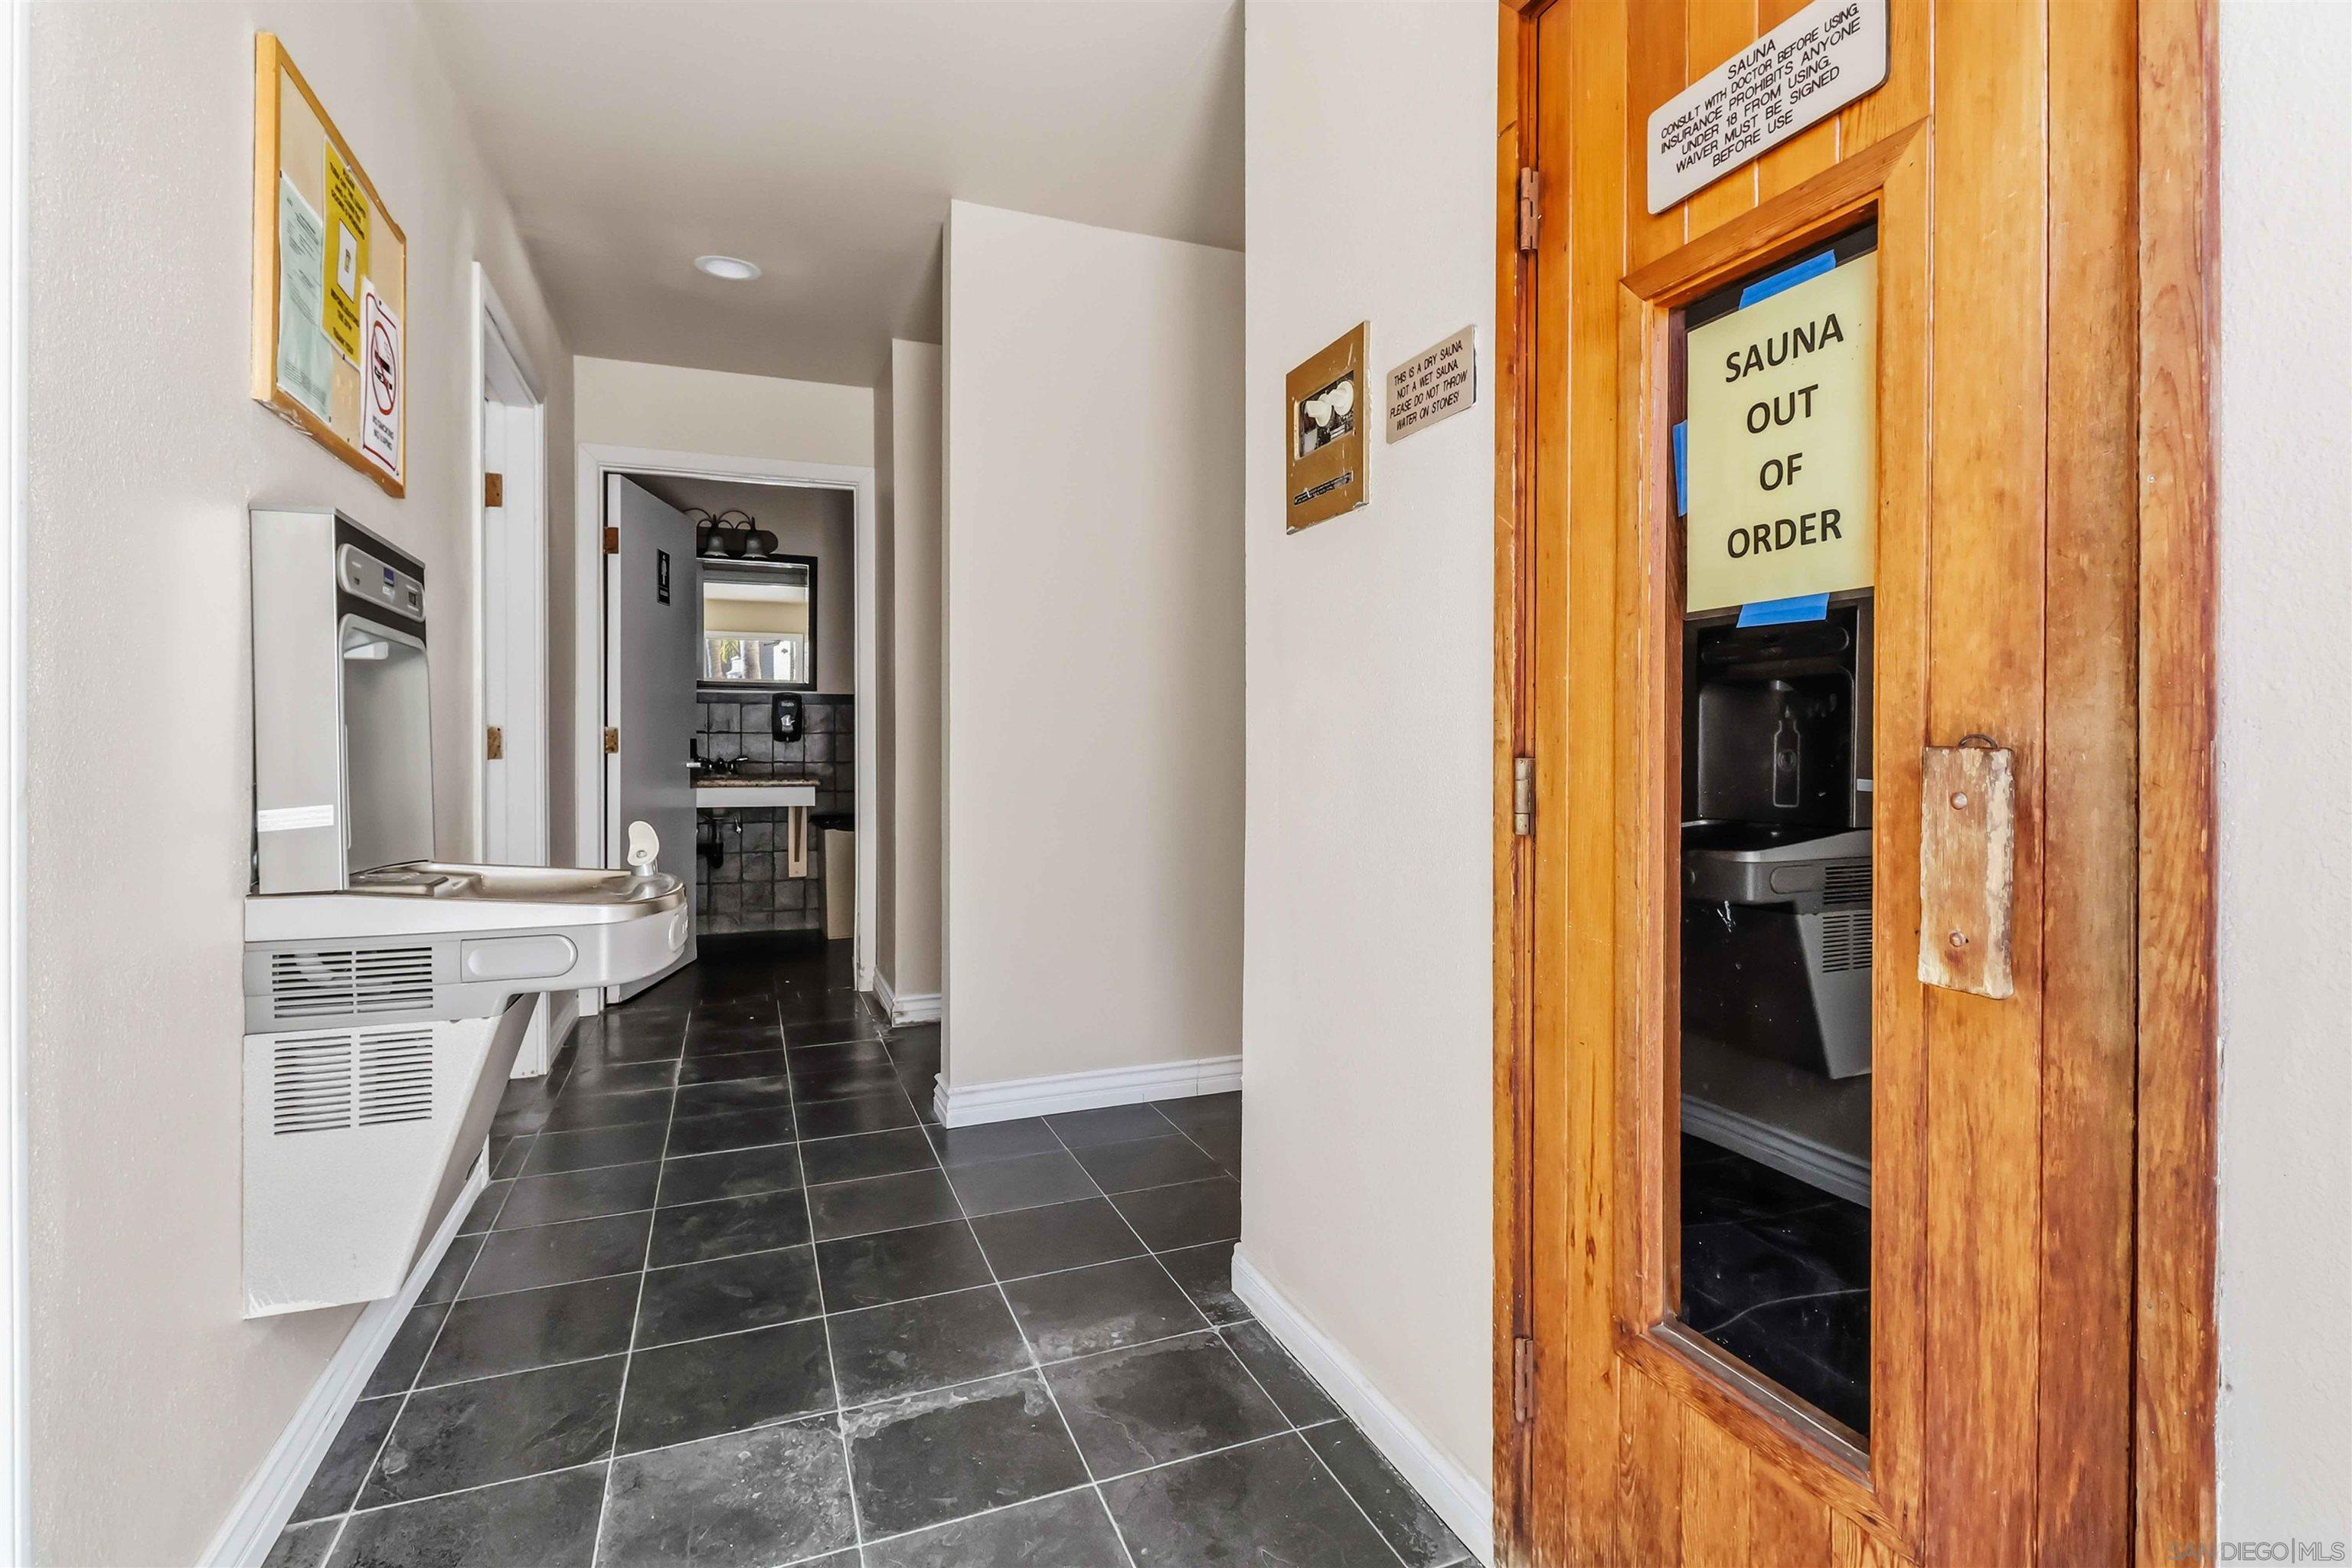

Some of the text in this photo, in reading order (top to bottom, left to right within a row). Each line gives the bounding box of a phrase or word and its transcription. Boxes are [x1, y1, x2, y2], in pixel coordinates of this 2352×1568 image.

[1661, 3, 1859, 139] CONSULT WITH DOCTOR BEFORE USING
[1728, 39, 1775, 80] SAUNA
[1661, 17, 1860, 154] INSURANCE PROHIBITS ANYONE
[1682, 56, 1831, 155] UNDER 18 FROM USING
[1676, 66, 1840, 173] WAIVER MUST BE SIGNED
[1713, 109, 1793, 167] BEFORE USE
[1394, 340, 1463, 386] THIS IS A DRY SAUNA
[1725, 312, 1844, 383] SAUNA
[1390, 369, 1468, 419] PLEASE DO NOT THROW
[1396, 358, 1459, 400] NOT A WET SAUNA
[1396, 411, 1417, 430] WATER
[1419, 405, 1429, 420] ON
[1746, 384, 1818, 434] OUT
[1759, 452, 1803, 492] OF
[1727, 508, 1842, 559] ORDER
